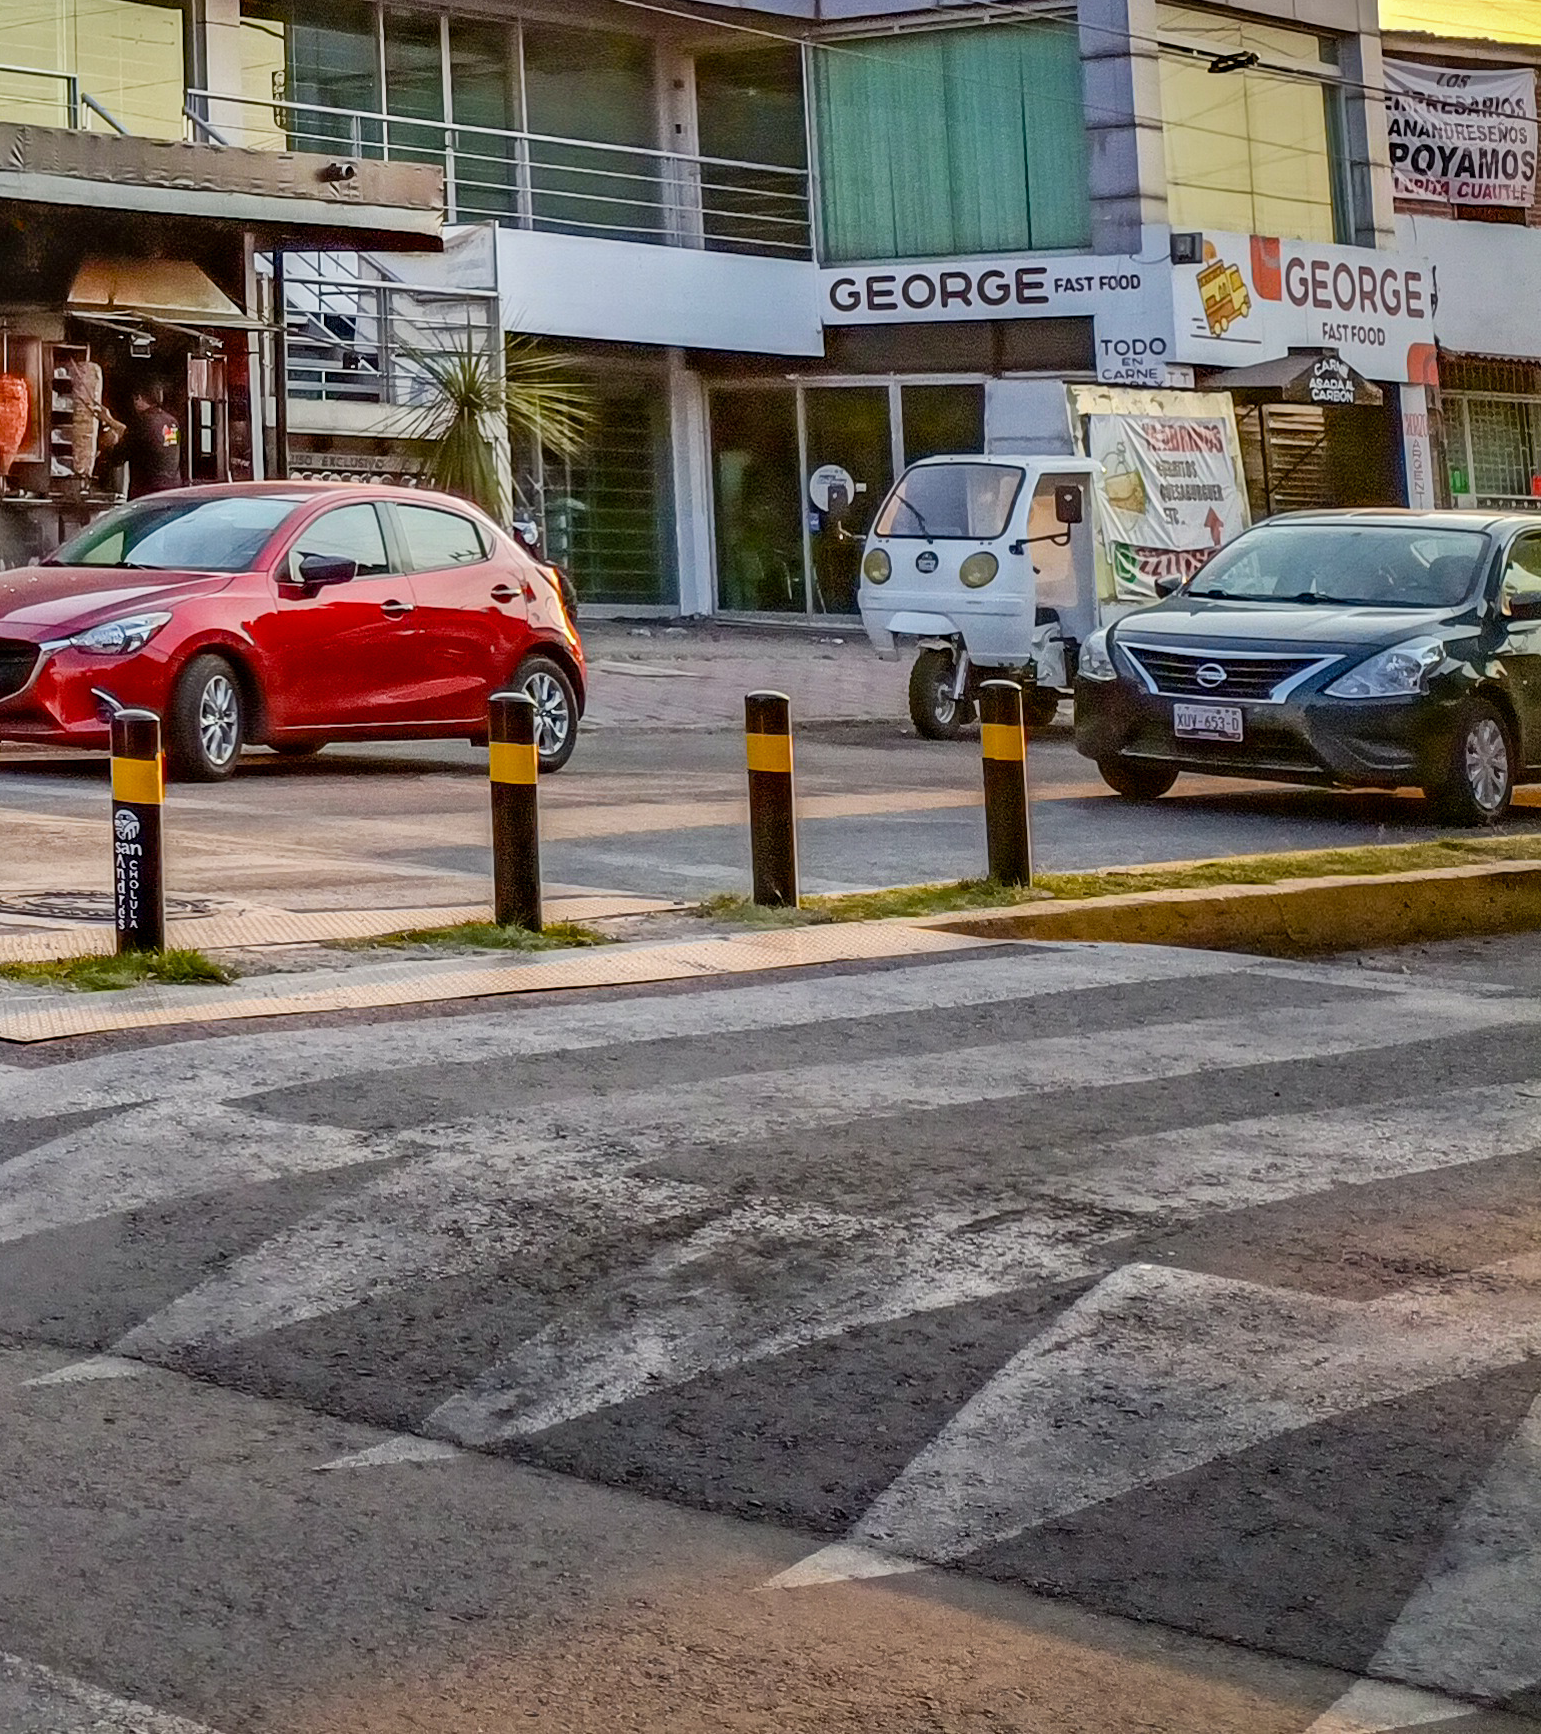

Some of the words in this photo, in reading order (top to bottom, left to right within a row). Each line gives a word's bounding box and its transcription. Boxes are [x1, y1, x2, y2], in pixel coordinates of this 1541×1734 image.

[1436, 72, 1472, 89] LOS
[1388, 141, 1536, 182] POYAMOS
[1456, 180, 1527, 202] CUAUTLE
[828, 266, 1050, 312] GEORGE
[1053, 275, 1095, 294] FAST
[1098, 273, 1141, 291] FOOD
[1284, 256, 1425, 319] GEORGE
[1321, 321, 1349, 344] FAST
[1350, 324, 1386, 347] FOOD
[1100, 337, 1167, 356] TODO
[1121, 356, 1144, 367] EN
[1101, 368, 1158, 381] CARNE
[114, 842, 143, 857] san
[128, 860, 139, 929] CHOLULA
